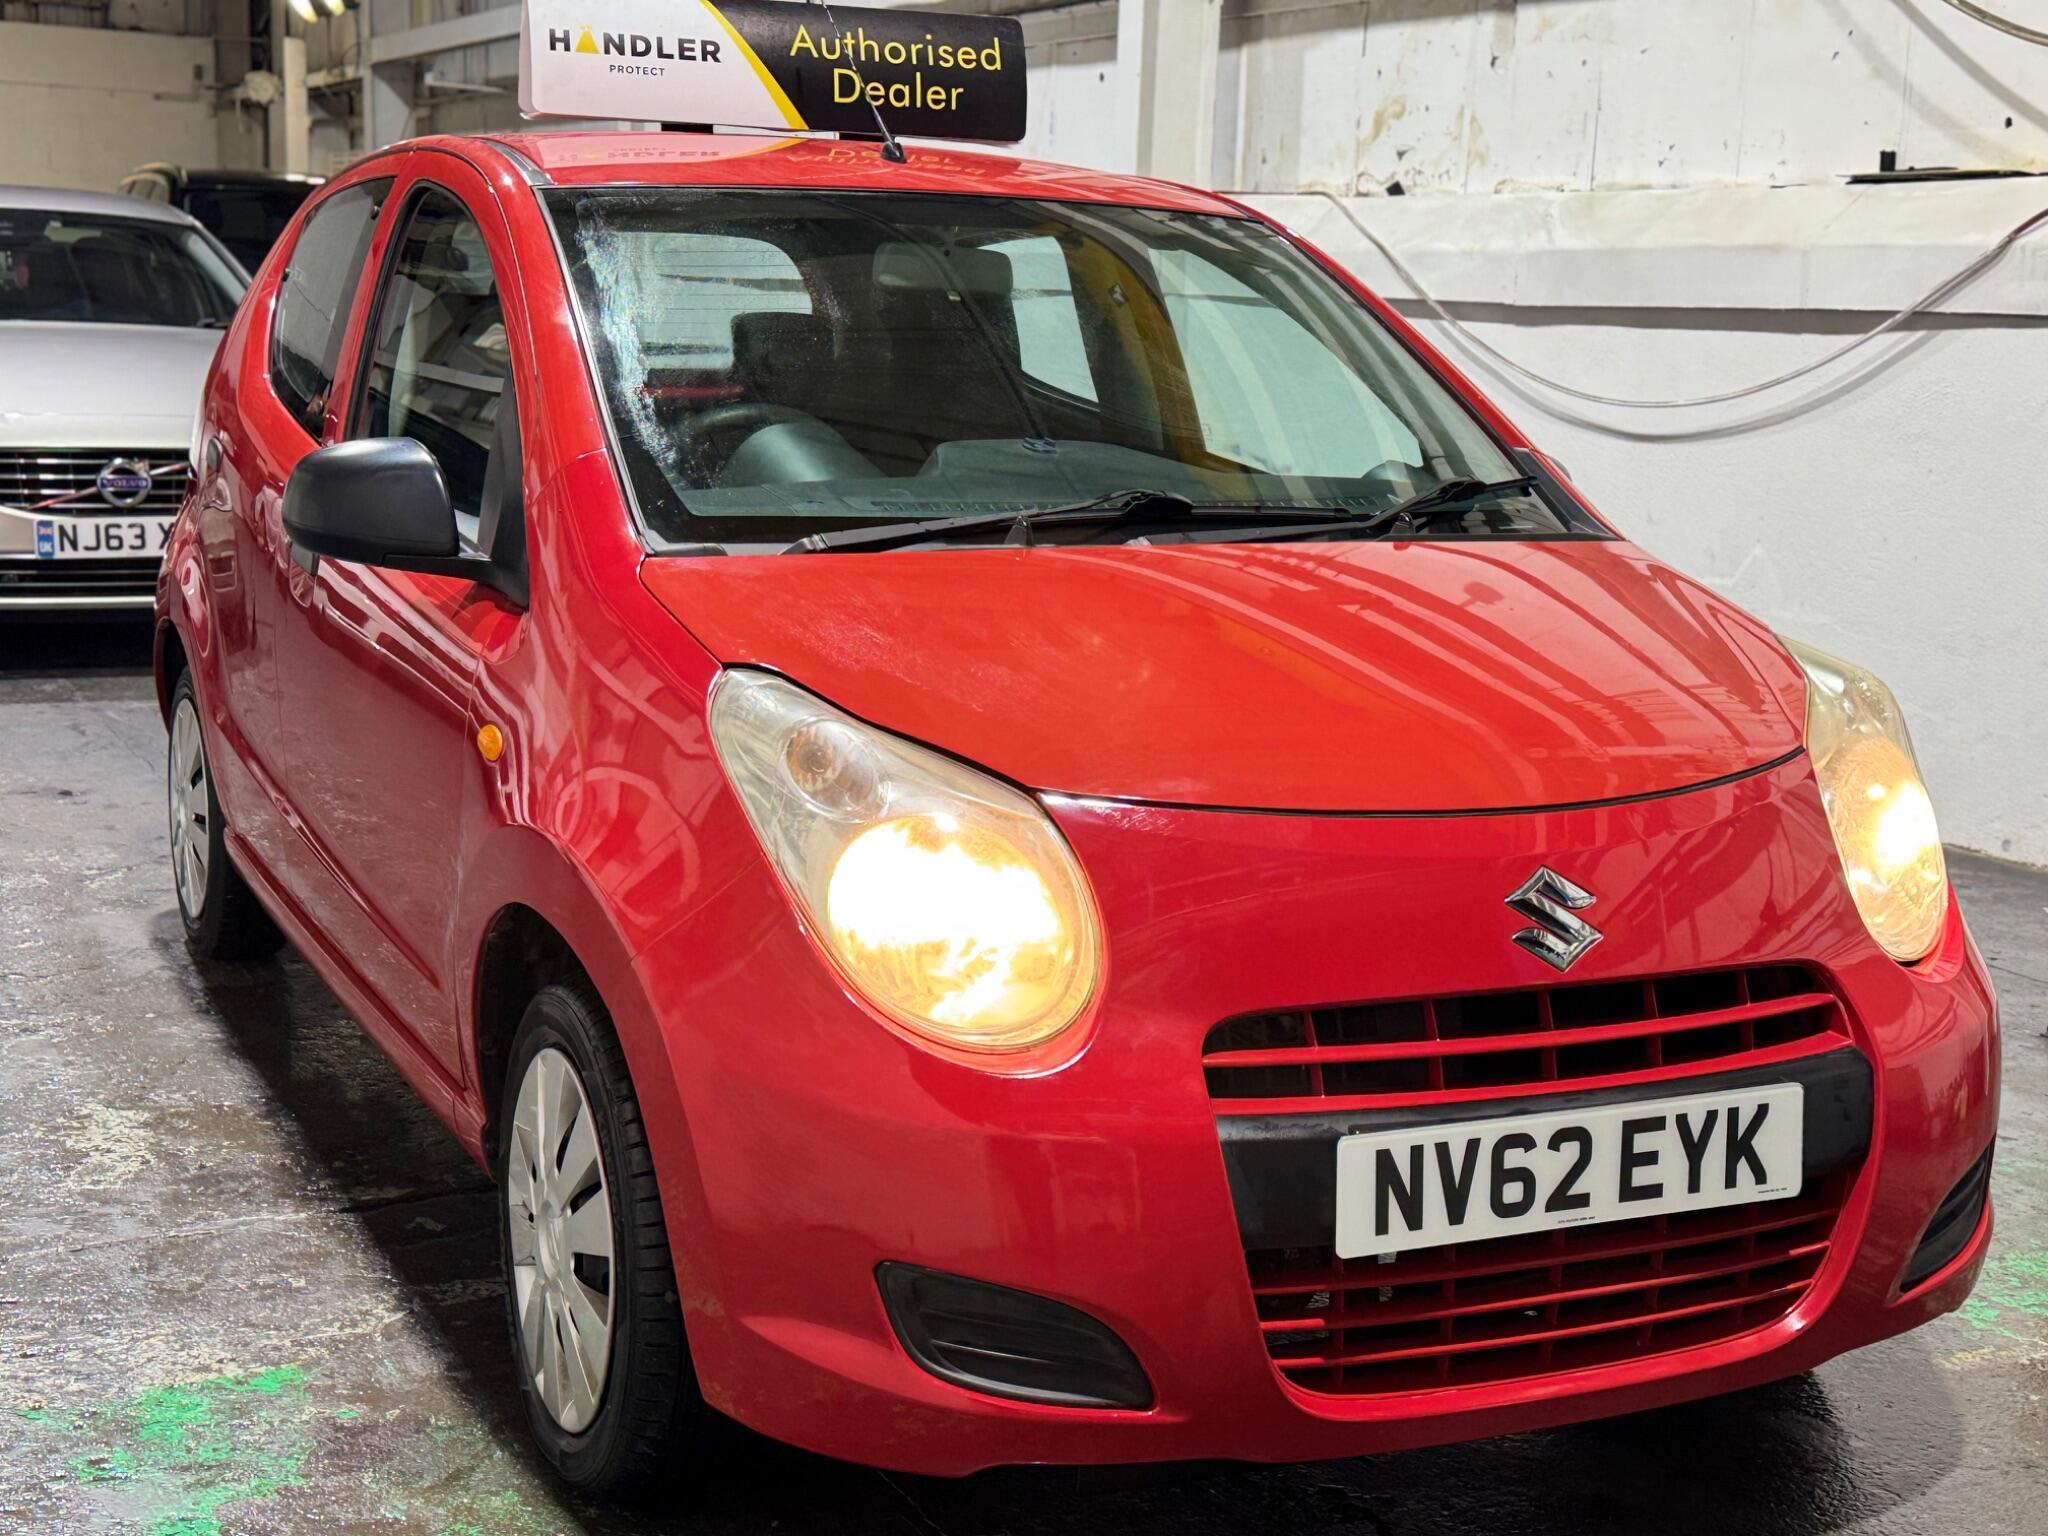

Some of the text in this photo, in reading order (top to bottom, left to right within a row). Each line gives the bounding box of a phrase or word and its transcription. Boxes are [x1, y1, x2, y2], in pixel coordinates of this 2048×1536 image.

[789, 24, 1002, 71] Authorised
[609, 64, 665, 77] PROTECT
[833, 67, 964, 111] Dealer
[102, 478, 148, 488] VOLVO
[58, 523, 146, 552] NJ63
[1375, 1102, 1770, 1237] NV62 EYK
